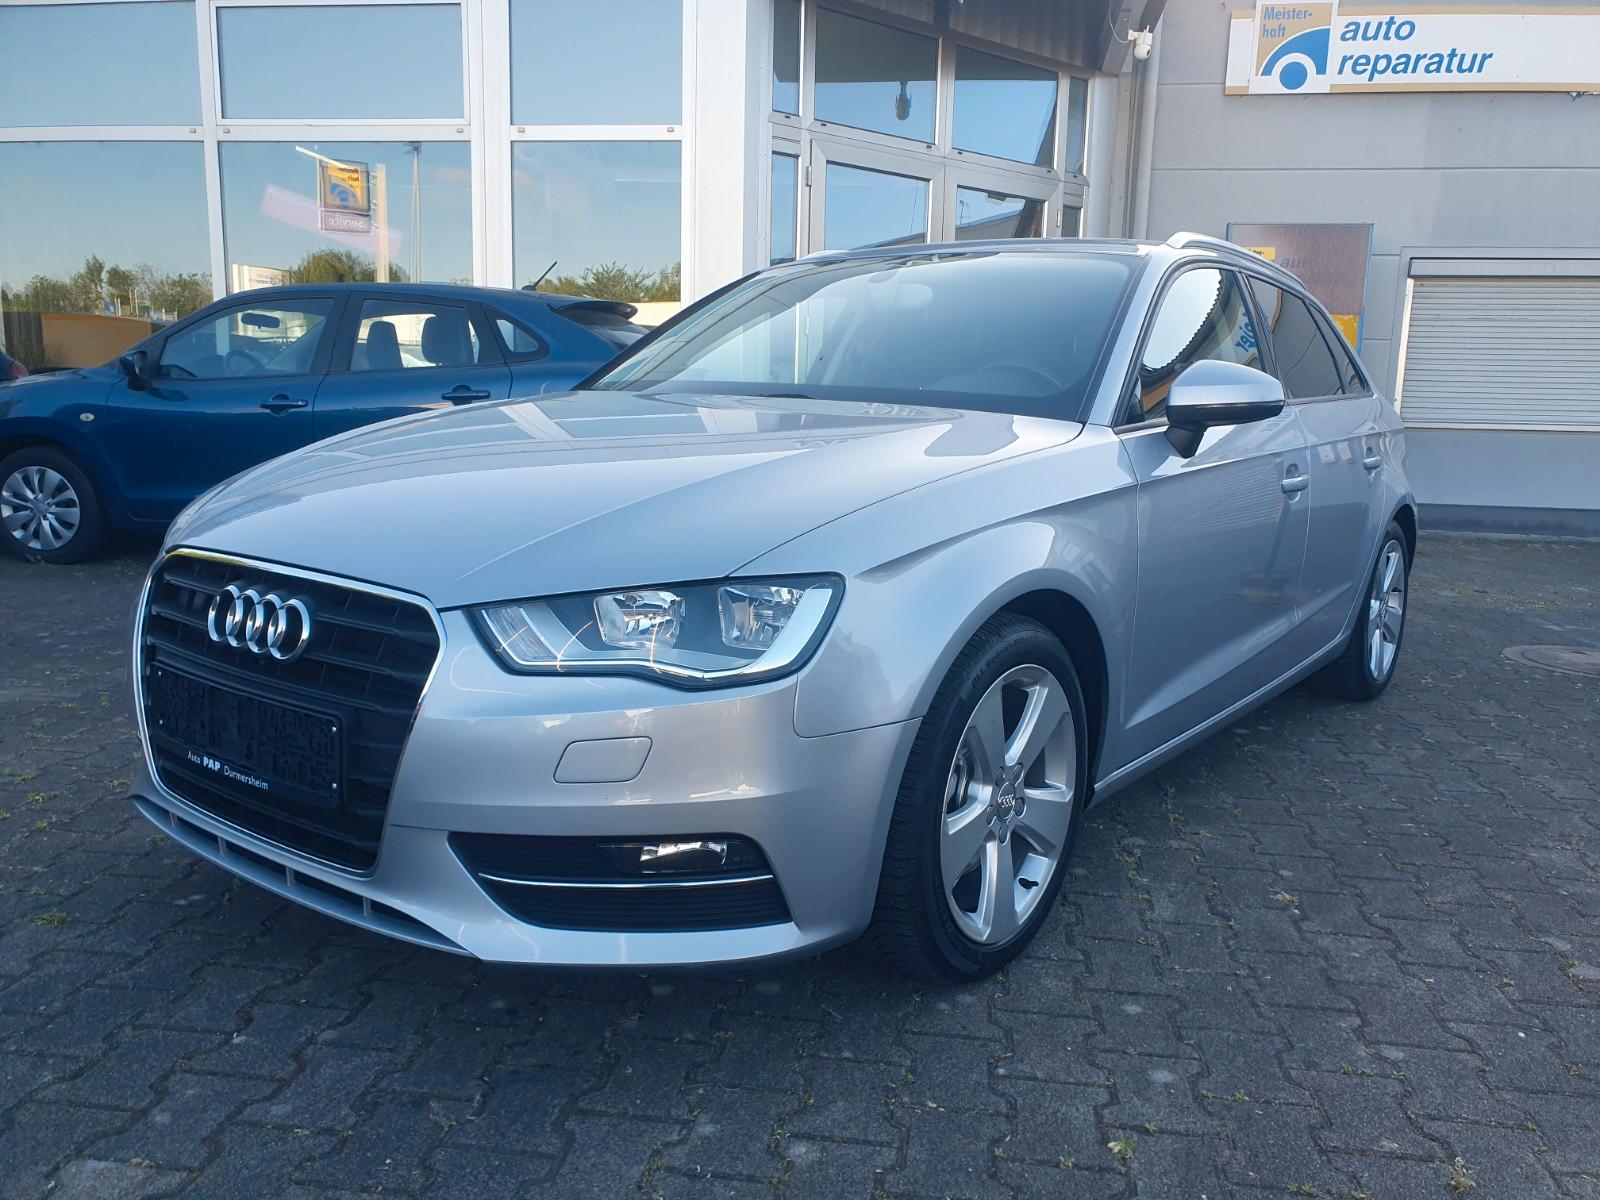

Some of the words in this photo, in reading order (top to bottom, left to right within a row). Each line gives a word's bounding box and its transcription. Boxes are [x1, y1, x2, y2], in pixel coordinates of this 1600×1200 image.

[1263, 6, 1313, 21] Meister-
[1262, 23, 1286, 39] haft
[1340, 16, 1416, 42] auto
[1337, 47, 1494, 82] reparatur
[188, 752, 201, 764] Auto
[203, 757, 221, 771] PAP
[224, 766, 269, 790] Durmersheim
